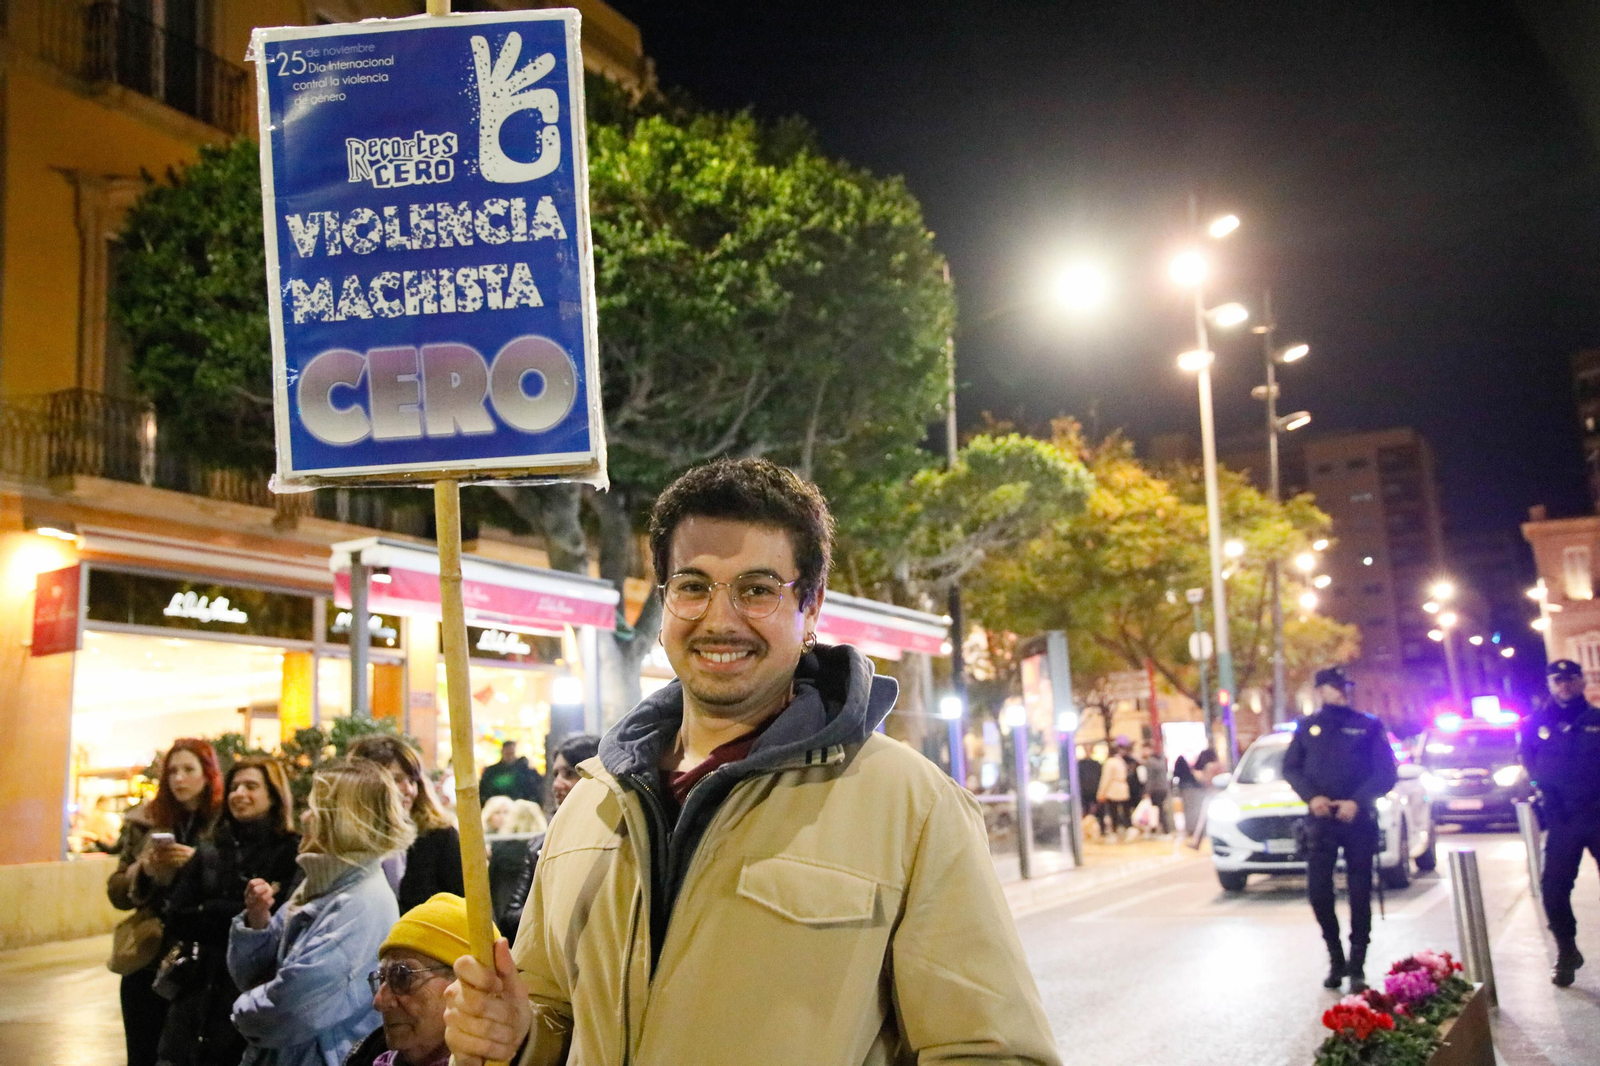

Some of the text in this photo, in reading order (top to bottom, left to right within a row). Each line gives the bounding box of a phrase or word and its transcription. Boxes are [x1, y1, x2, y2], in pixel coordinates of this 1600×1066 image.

[276, 50, 307, 77] 25
[305, 42, 376, 58] de noviembre
[328, 54, 395, 71] Internacional
[292, 72, 389, 91] contral la violencia
[294, 96, 308, 106] de
[345, 130, 459, 183] Recortes
[372, 158, 455, 189] CERO
[285, 195, 568, 258] VIOLENCIA
[290, 262, 545, 324] MACHISTA
[297, 334, 578, 447] CERO
